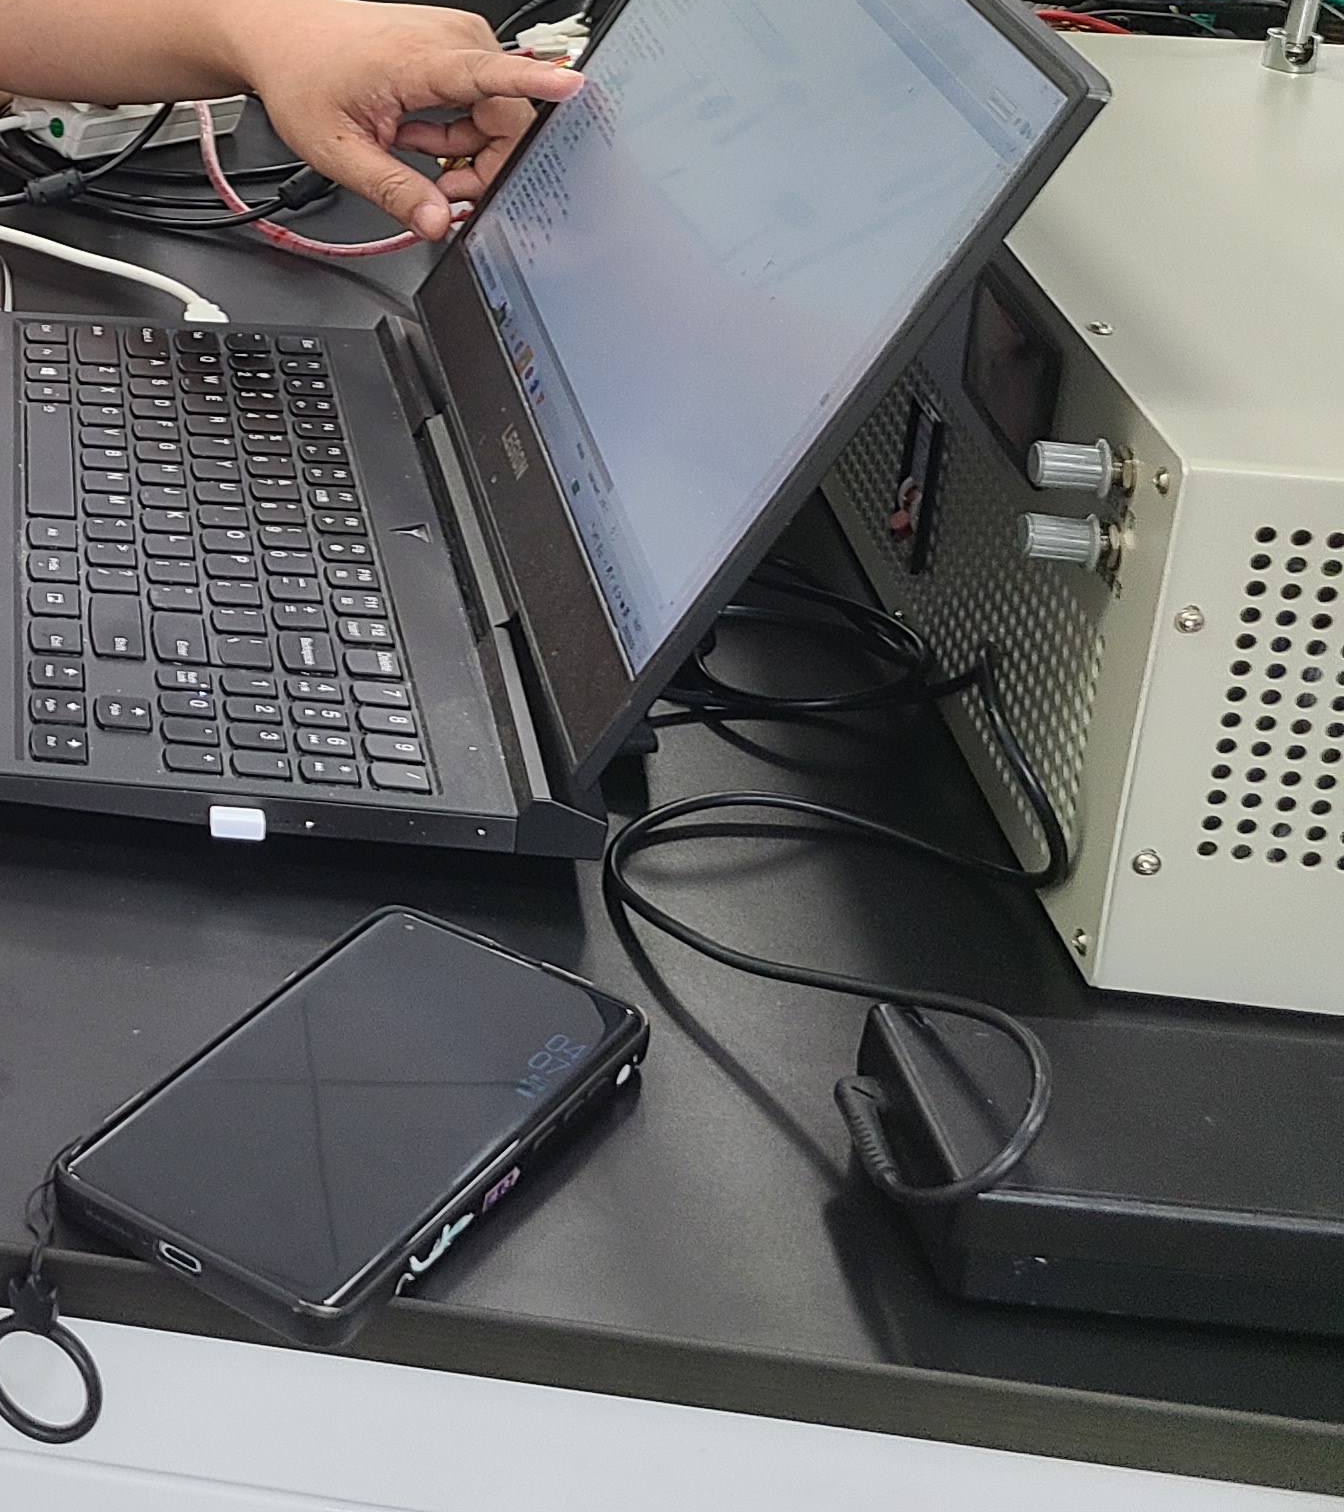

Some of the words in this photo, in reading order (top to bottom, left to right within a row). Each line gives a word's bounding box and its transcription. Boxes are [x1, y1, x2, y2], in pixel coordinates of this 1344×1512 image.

[204, 376, 219, 384] W
[109, 496, 126, 504] M
[231, 555, 249, 563] P
[364, 597, 378, 608] F11
[371, 624, 386, 636] F12
[177, 641, 189, 656] Enter
[377, 652, 393, 673] Delete
[260, 732, 279, 740] 3
